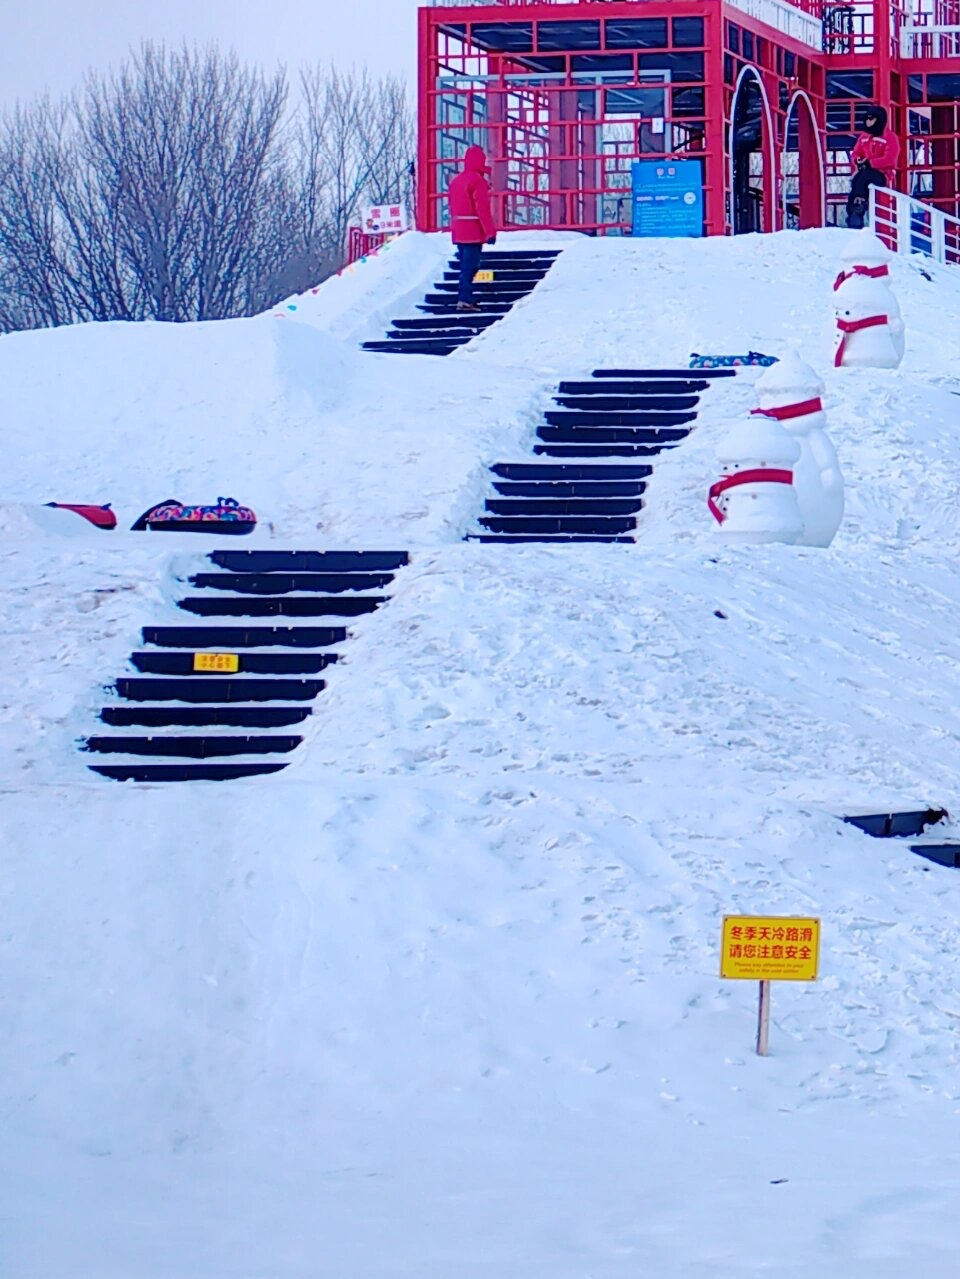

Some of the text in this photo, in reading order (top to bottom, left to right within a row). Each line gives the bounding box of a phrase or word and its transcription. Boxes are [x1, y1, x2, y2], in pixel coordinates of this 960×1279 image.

[731, 926, 813, 941] 冬季天冷路滑
[729, 944, 812, 960] 请您注意安全
